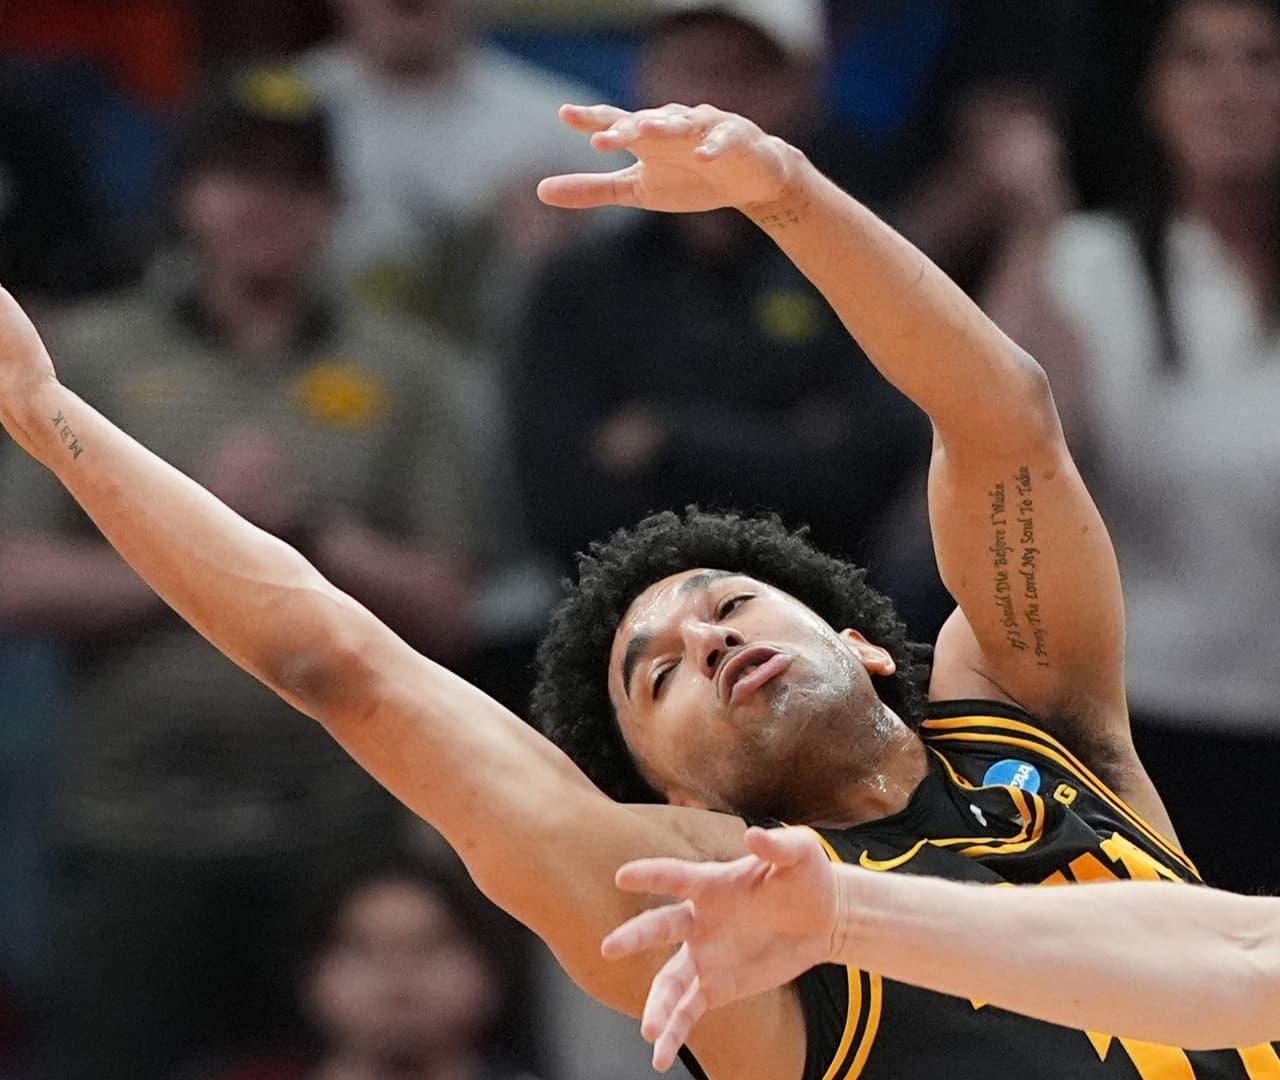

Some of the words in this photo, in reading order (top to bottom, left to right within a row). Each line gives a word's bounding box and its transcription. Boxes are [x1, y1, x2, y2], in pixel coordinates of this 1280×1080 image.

[1015, 466, 1032, 497] Take
[988, 481, 1005, 520] Wake
[1019, 499, 1034, 515] To
[1017, 517, 1035, 544] Soul
[989, 528, 1014, 567] Before
[1021, 547, 1041, 568] My
[994, 571, 1010, 593] Die
[1018, 569, 1038, 599] Lord
[994, 593, 1018, 628] Should
[1025, 603, 1041, 625] The
